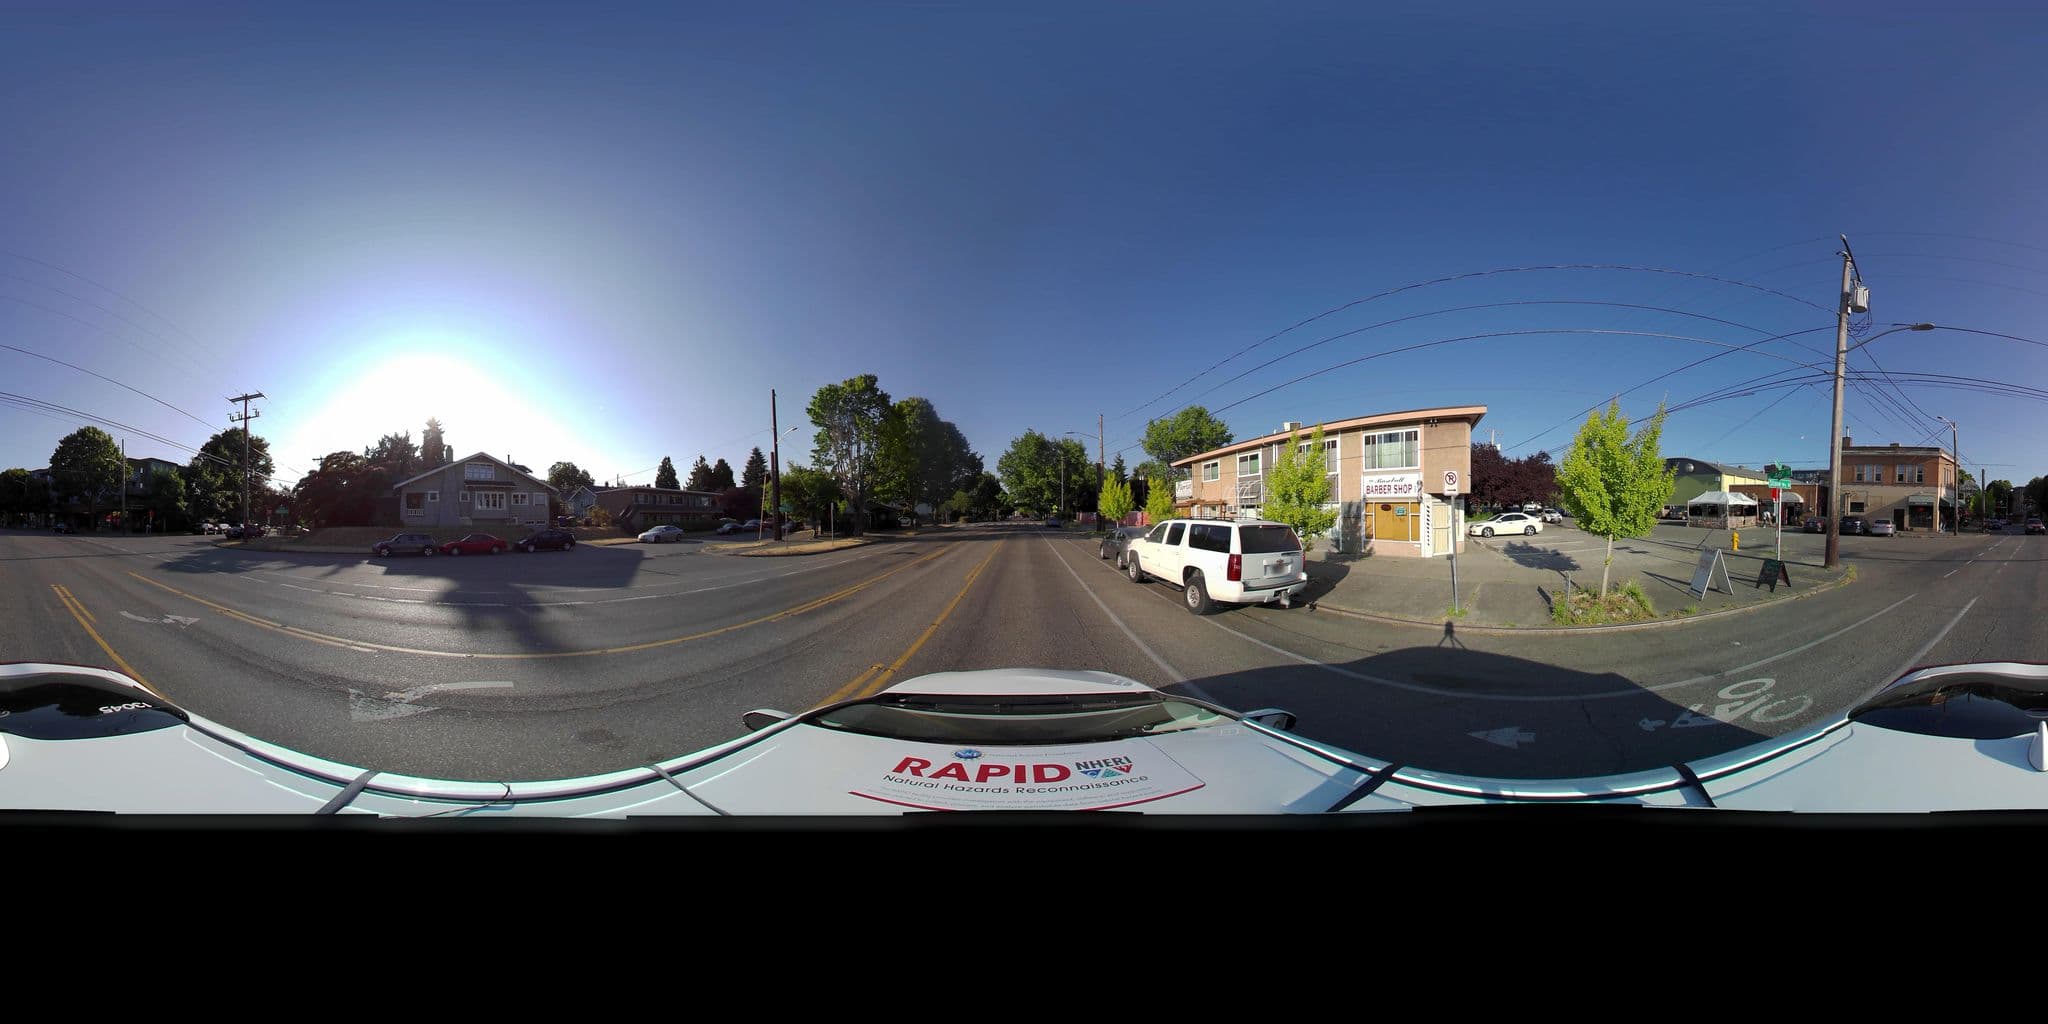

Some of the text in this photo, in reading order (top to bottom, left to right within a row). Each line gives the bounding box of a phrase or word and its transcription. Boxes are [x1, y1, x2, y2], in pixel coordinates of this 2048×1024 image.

[1366, 484, 1391, 494] BARBER
[1393, 483, 1412, 494] SHOP
[98, 702, 152, 714] 13045
[892, 756, 1071, 784] RAPID
[1075, 755, 1133, 771] NHERI
[883, 773, 1149, 794] Natural Hazards Reconnaissance
